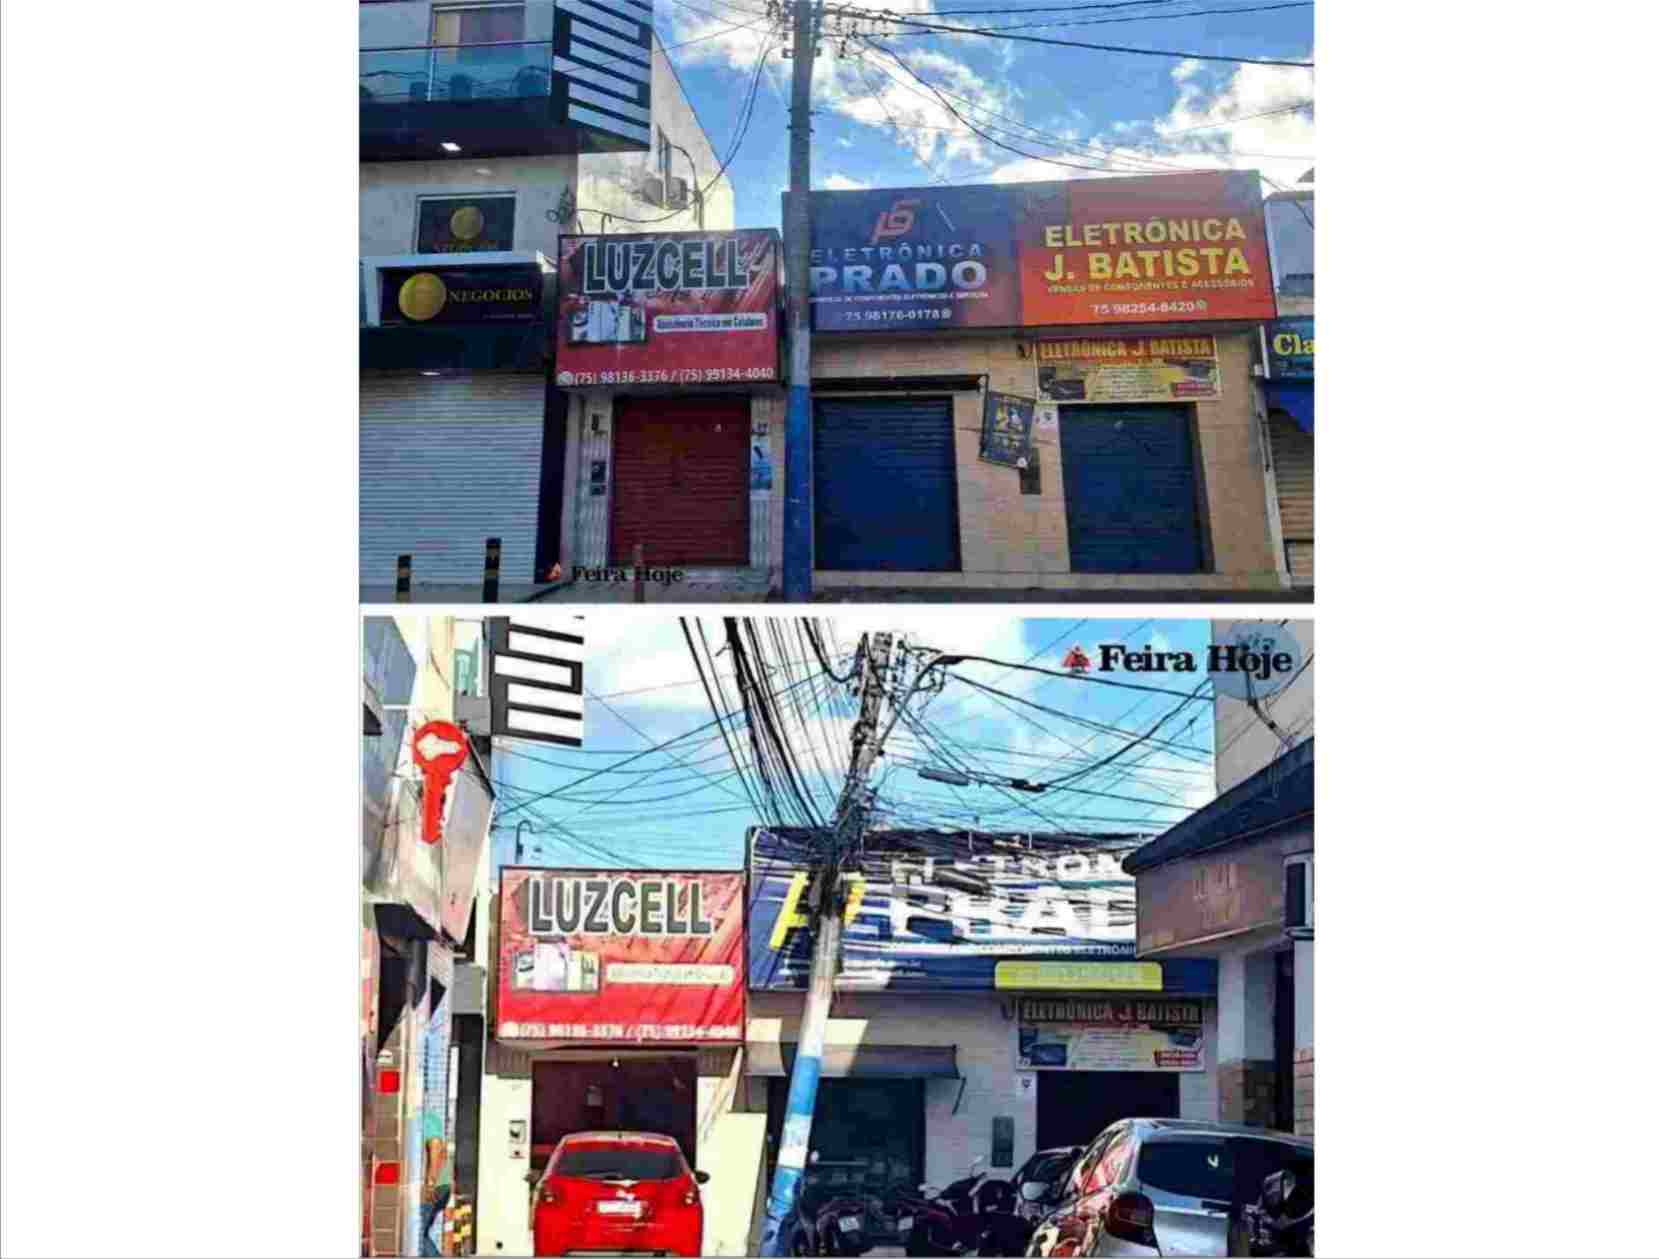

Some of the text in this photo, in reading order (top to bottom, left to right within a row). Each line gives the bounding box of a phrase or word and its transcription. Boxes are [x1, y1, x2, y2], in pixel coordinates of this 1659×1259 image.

[1045, 216, 1247, 247] ELETRÔNICA
[583, 238, 749, 294] LUZCELL
[809, 242, 983, 263] ELETRÔNICA
[1043, 248, 1251, 282] J. BATISTA
[808, 260, 987, 292] PRADO
[1150, 338, 1215, 358] BATISTA
[574, 370, 597, 385] (75)
[679, 368, 702, 383] (75)
[528, 877, 714, 936] LUZCELL
[1136, 1001, 1200, 1022] BATISTA
